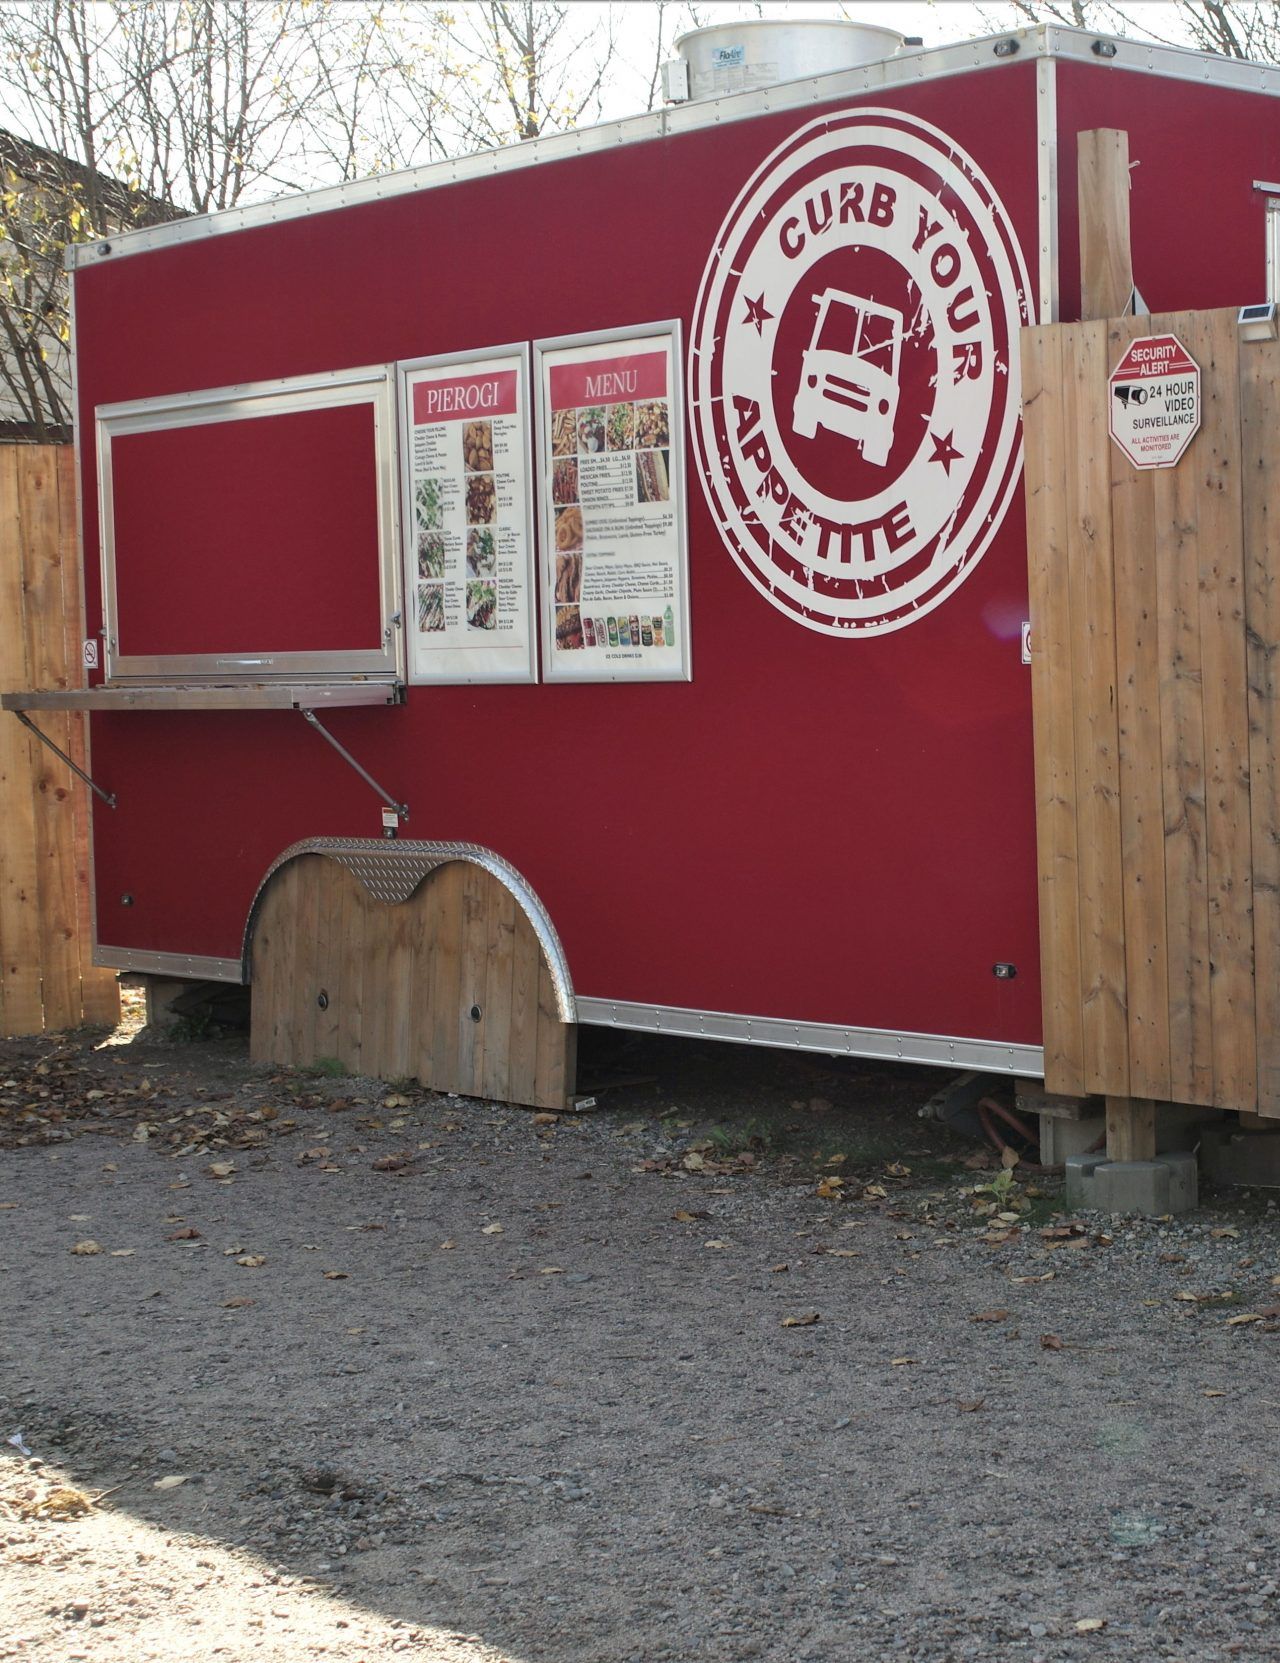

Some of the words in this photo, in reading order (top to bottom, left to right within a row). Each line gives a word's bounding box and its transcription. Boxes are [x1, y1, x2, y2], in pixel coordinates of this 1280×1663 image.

[780, 182, 897, 260] CURB
[911, 204, 984, 387] YOUR
[1131, 345, 1177, 362] SECURITY
[1140, 361, 1170, 376] ALERT
[584, 369, 638, 399] MENU
[1149, 386, 1162, 399] 24
[1165, 381, 1195, 397] HOUR
[426, 382, 499, 414] PIEROGI
[1164, 397, 1195, 412] VIDEO
[1132, 413, 1195, 430] SURVEILLANCE
[1131, 437, 1142, 445] ALL
[1142, 434, 1169, 444] ACTIVITIES
[1170, 433, 1180, 441] ARE
[1140, 443, 1172, 452] MONITORED
[732, 394, 917, 564] APPETITE
